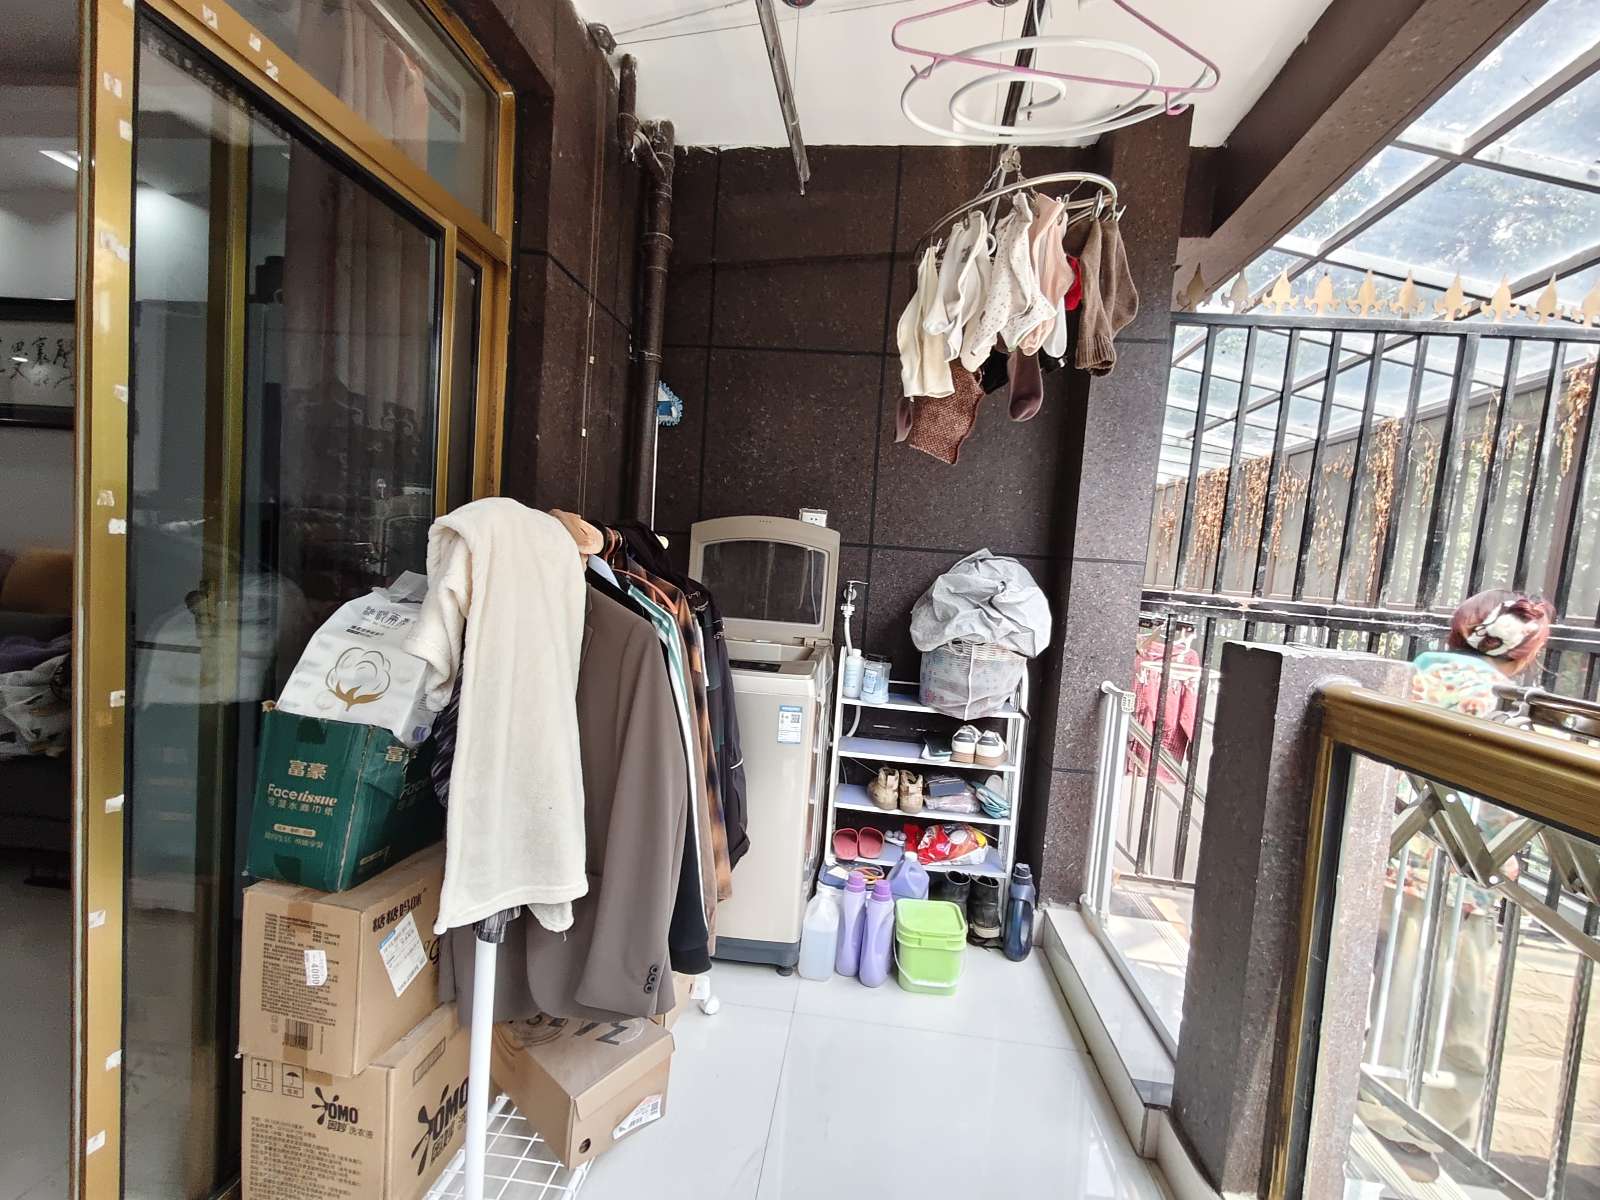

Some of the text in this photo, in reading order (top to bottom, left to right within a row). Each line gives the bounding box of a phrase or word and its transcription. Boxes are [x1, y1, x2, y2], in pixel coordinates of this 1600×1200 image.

[288, 760, 328, 780] 富豪
[327, 1102, 358, 1124] OMO
[432, 1076, 469, 1141] OMO
